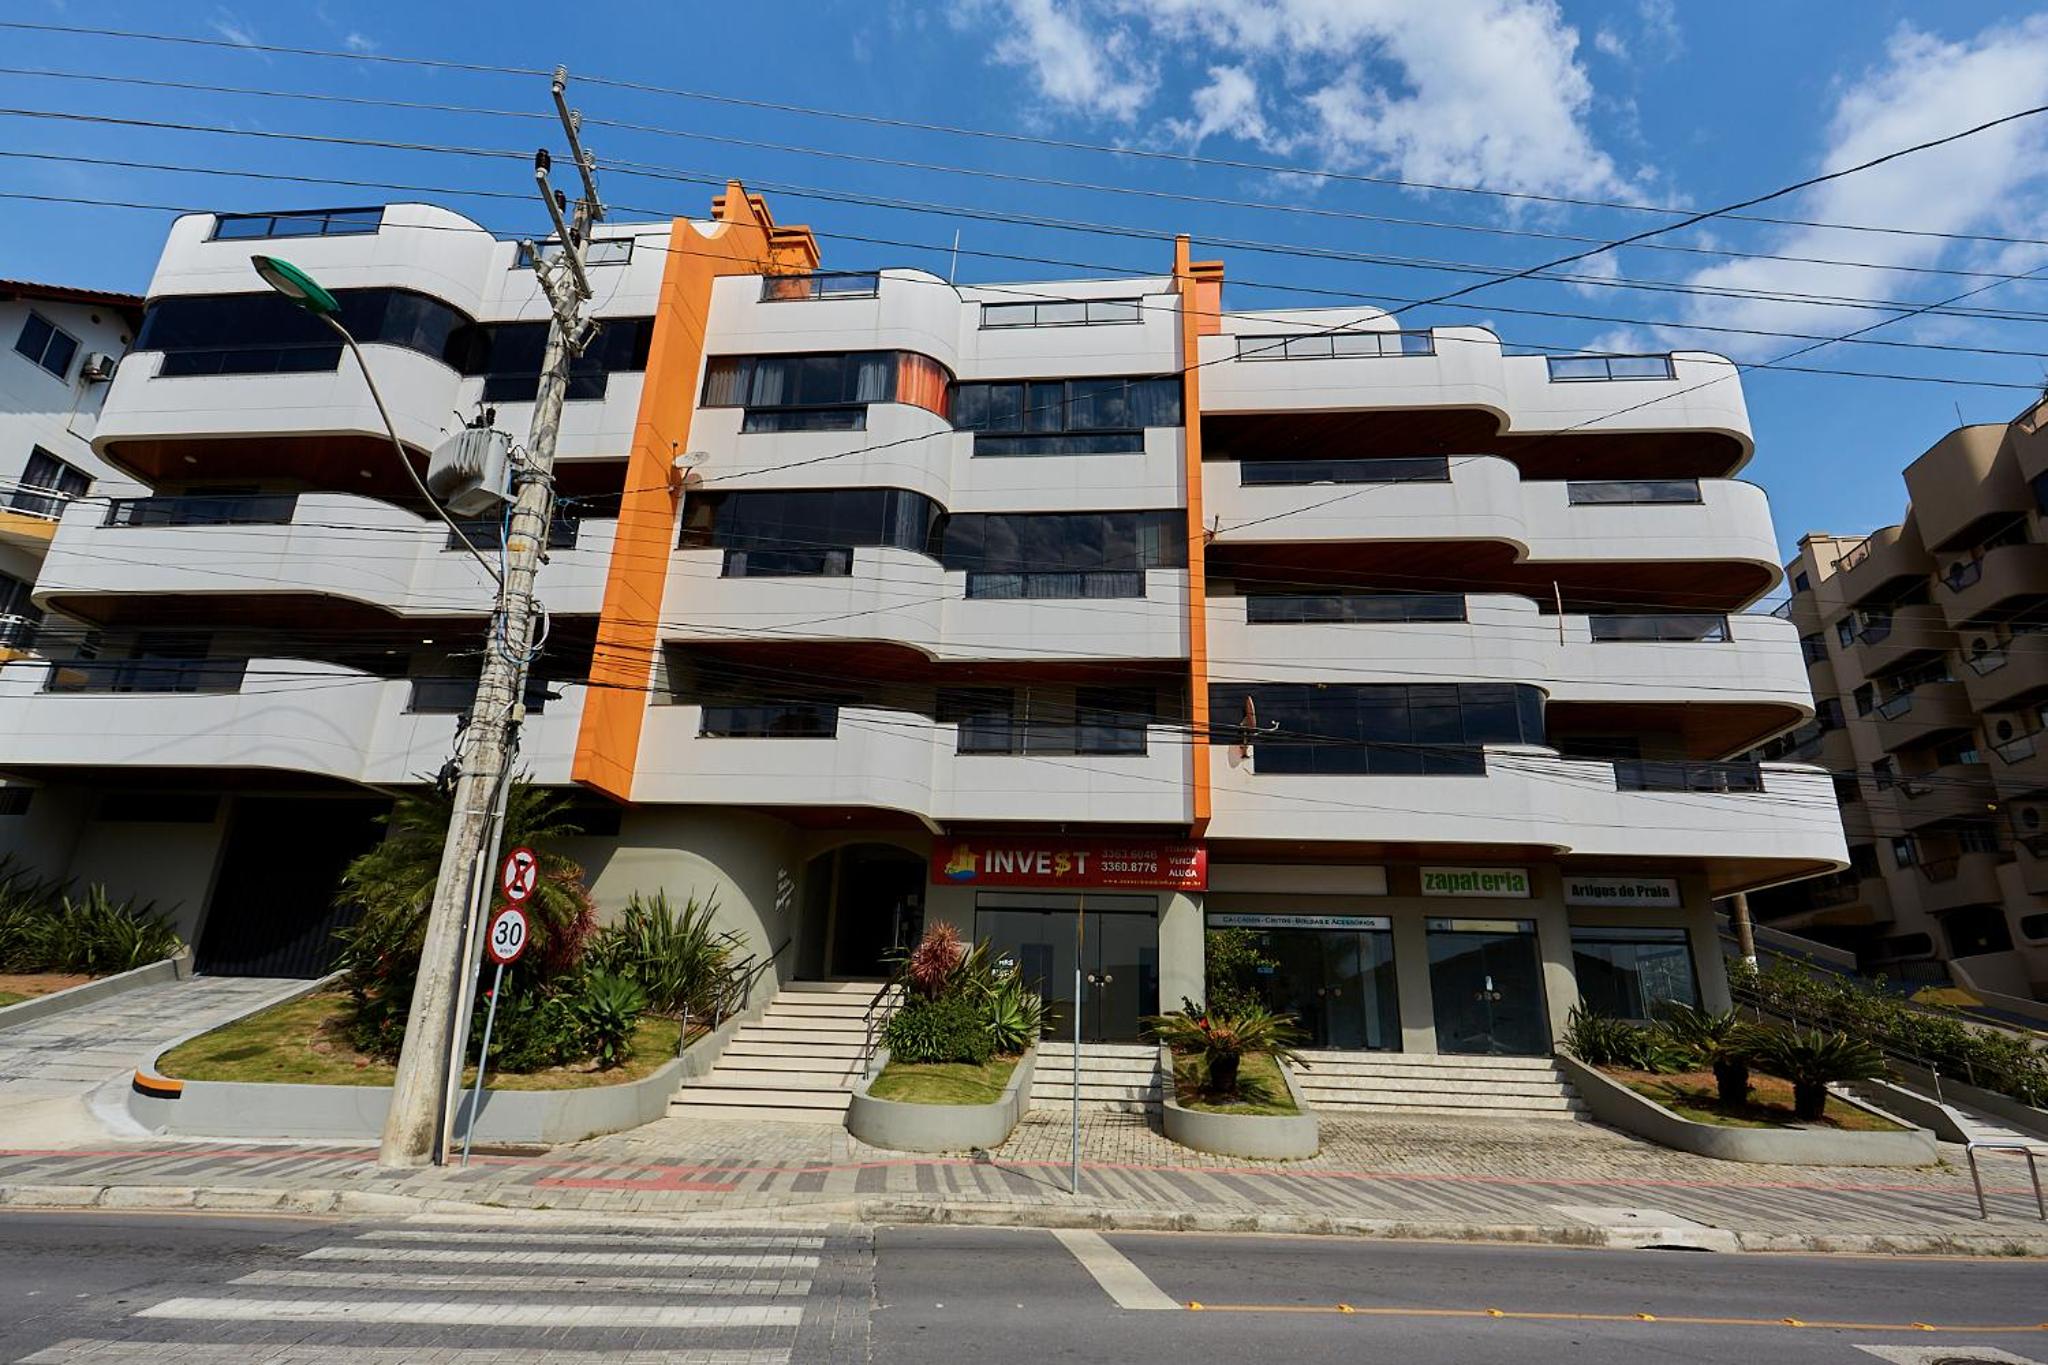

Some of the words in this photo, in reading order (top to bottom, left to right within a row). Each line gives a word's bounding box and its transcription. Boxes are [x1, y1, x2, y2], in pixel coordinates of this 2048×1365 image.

[1101, 861, 1157, 873] 3360.8776
[1169, 856, 1197, 865] VENDE
[1168, 869, 1197, 877] ALUGA
[1424, 871, 1525, 893] zapateria
[1572, 884, 1616, 898] Artigos
[1619, 884, 1634, 897] de
[1636, 885, 1669, 898] Praia
[495, 921, 522, 946] 30
